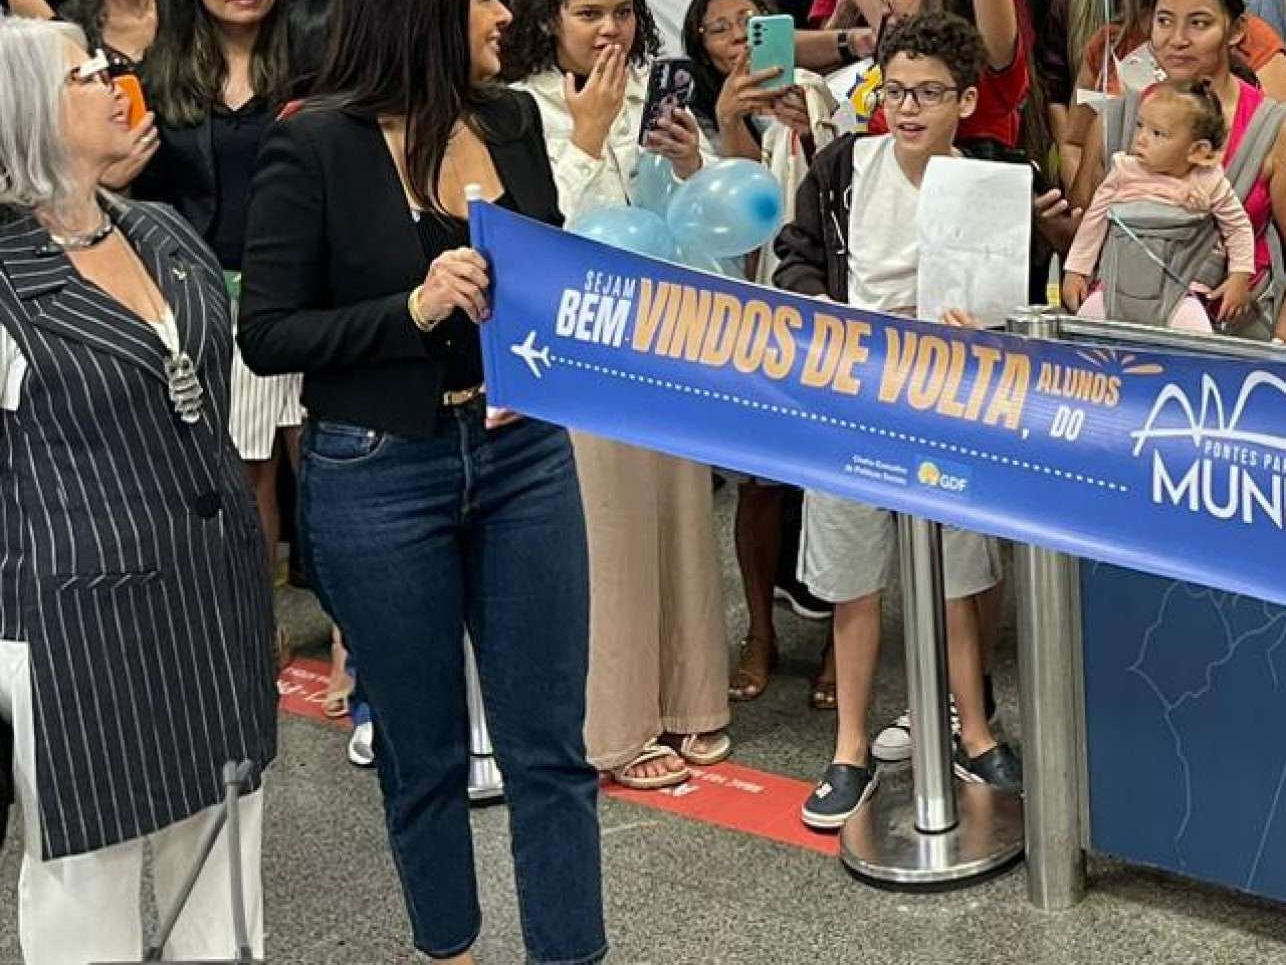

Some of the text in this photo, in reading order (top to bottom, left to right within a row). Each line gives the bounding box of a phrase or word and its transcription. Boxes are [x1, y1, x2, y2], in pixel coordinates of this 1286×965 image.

[584, 270, 636, 298] SEJAM
[800, 313, 872, 396] DE
[878, 327, 1031, 440] VOLTA,
[1036, 361, 1122, 407] ALUNOS
[1050, 405, 1086, 441] DO
[1204, 440, 1258, 466] PONTES
[940, 473, 968, 492] GDF
